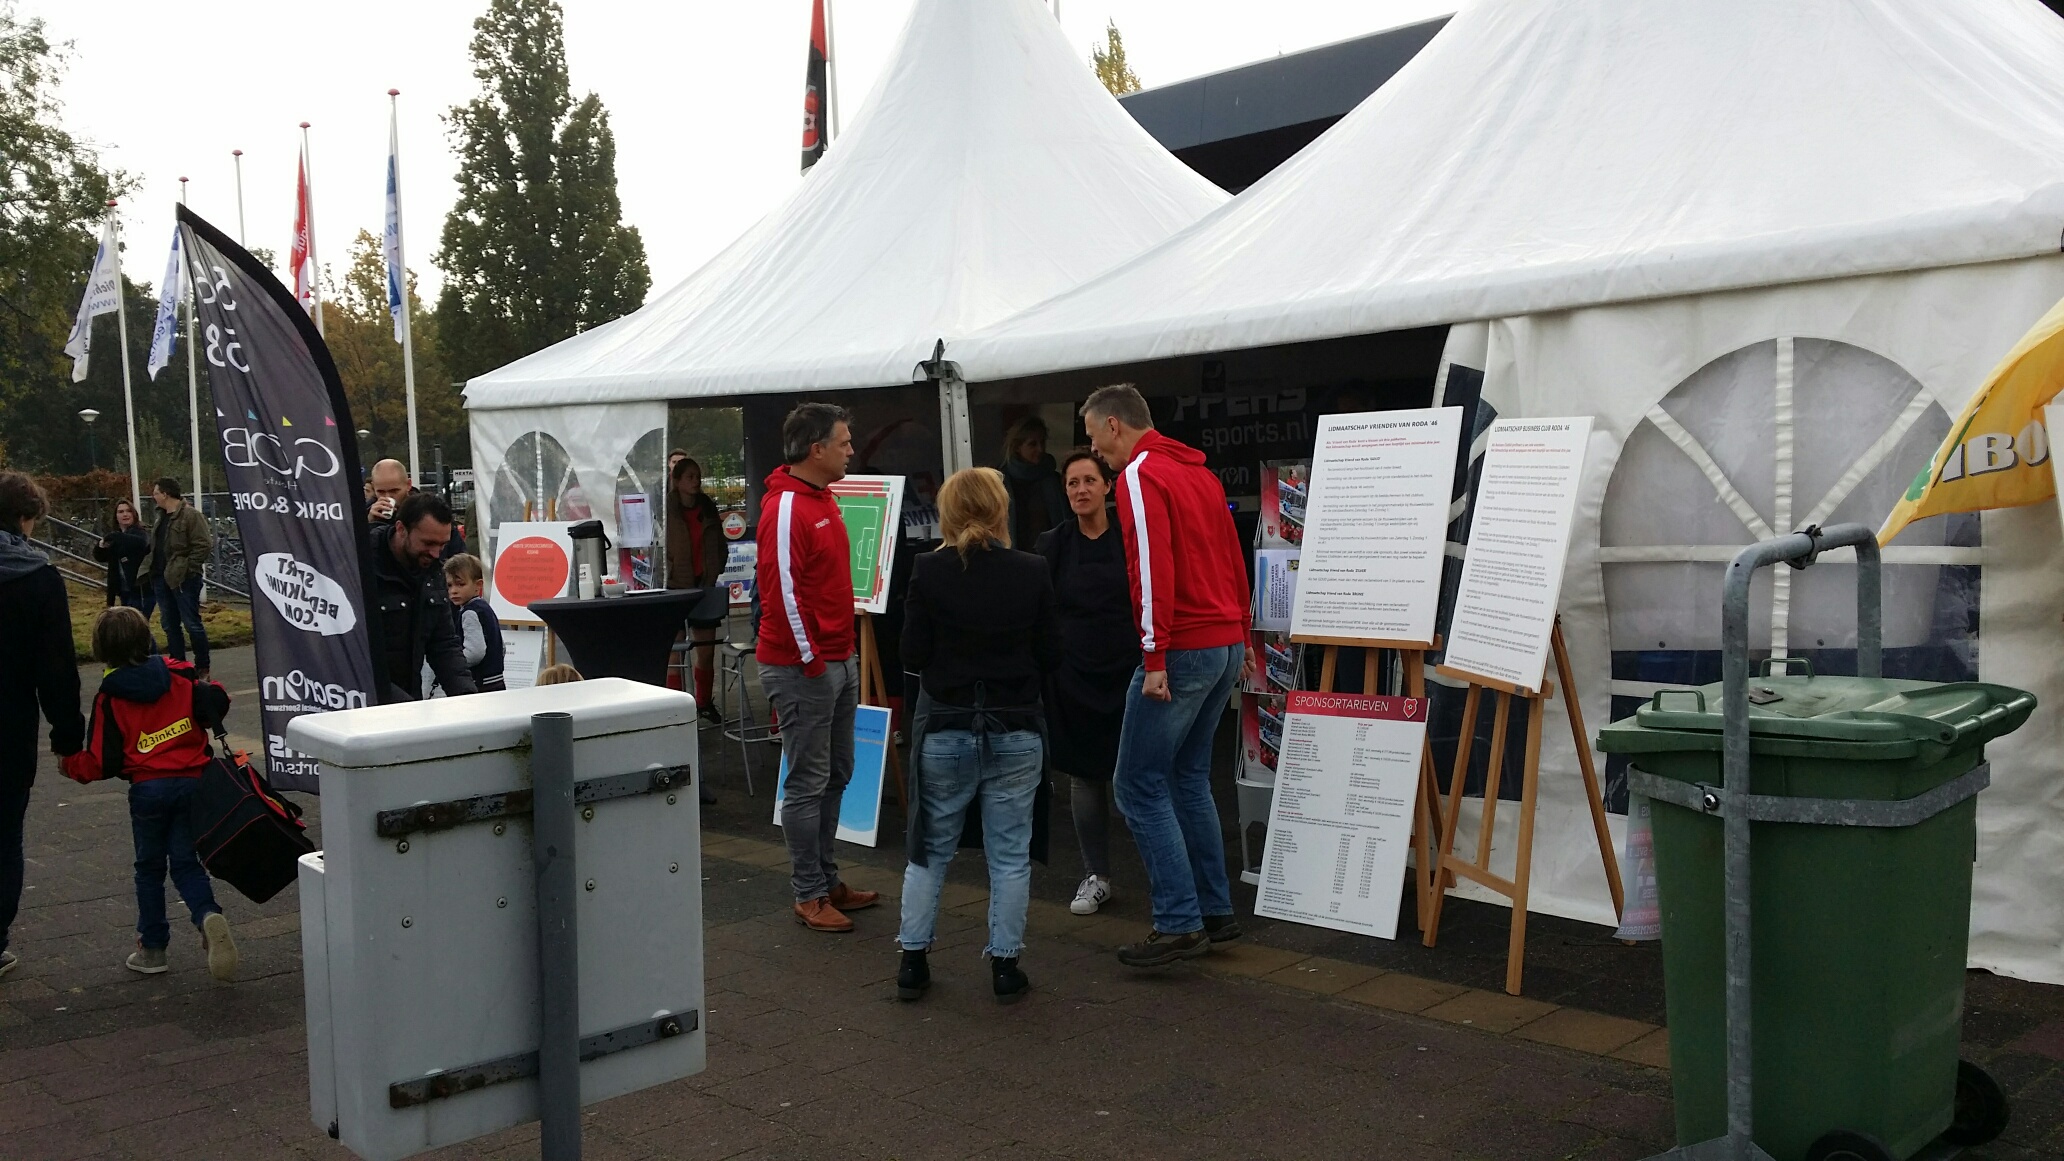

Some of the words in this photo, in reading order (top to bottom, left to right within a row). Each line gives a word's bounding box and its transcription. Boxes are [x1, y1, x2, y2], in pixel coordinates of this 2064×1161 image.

[1201, 412, 1309, 454] sports.nl
[1327, 423, 1368, 431] LIDMAATSCHAP
[1522, 424, 1541, 432] BUSINESS
[1551, 423, 1563, 431] RODA
[1294, 695, 1390, 712] SPONSORTARIEVEN
[139, 720, 191, 749] 123inkt.nl
